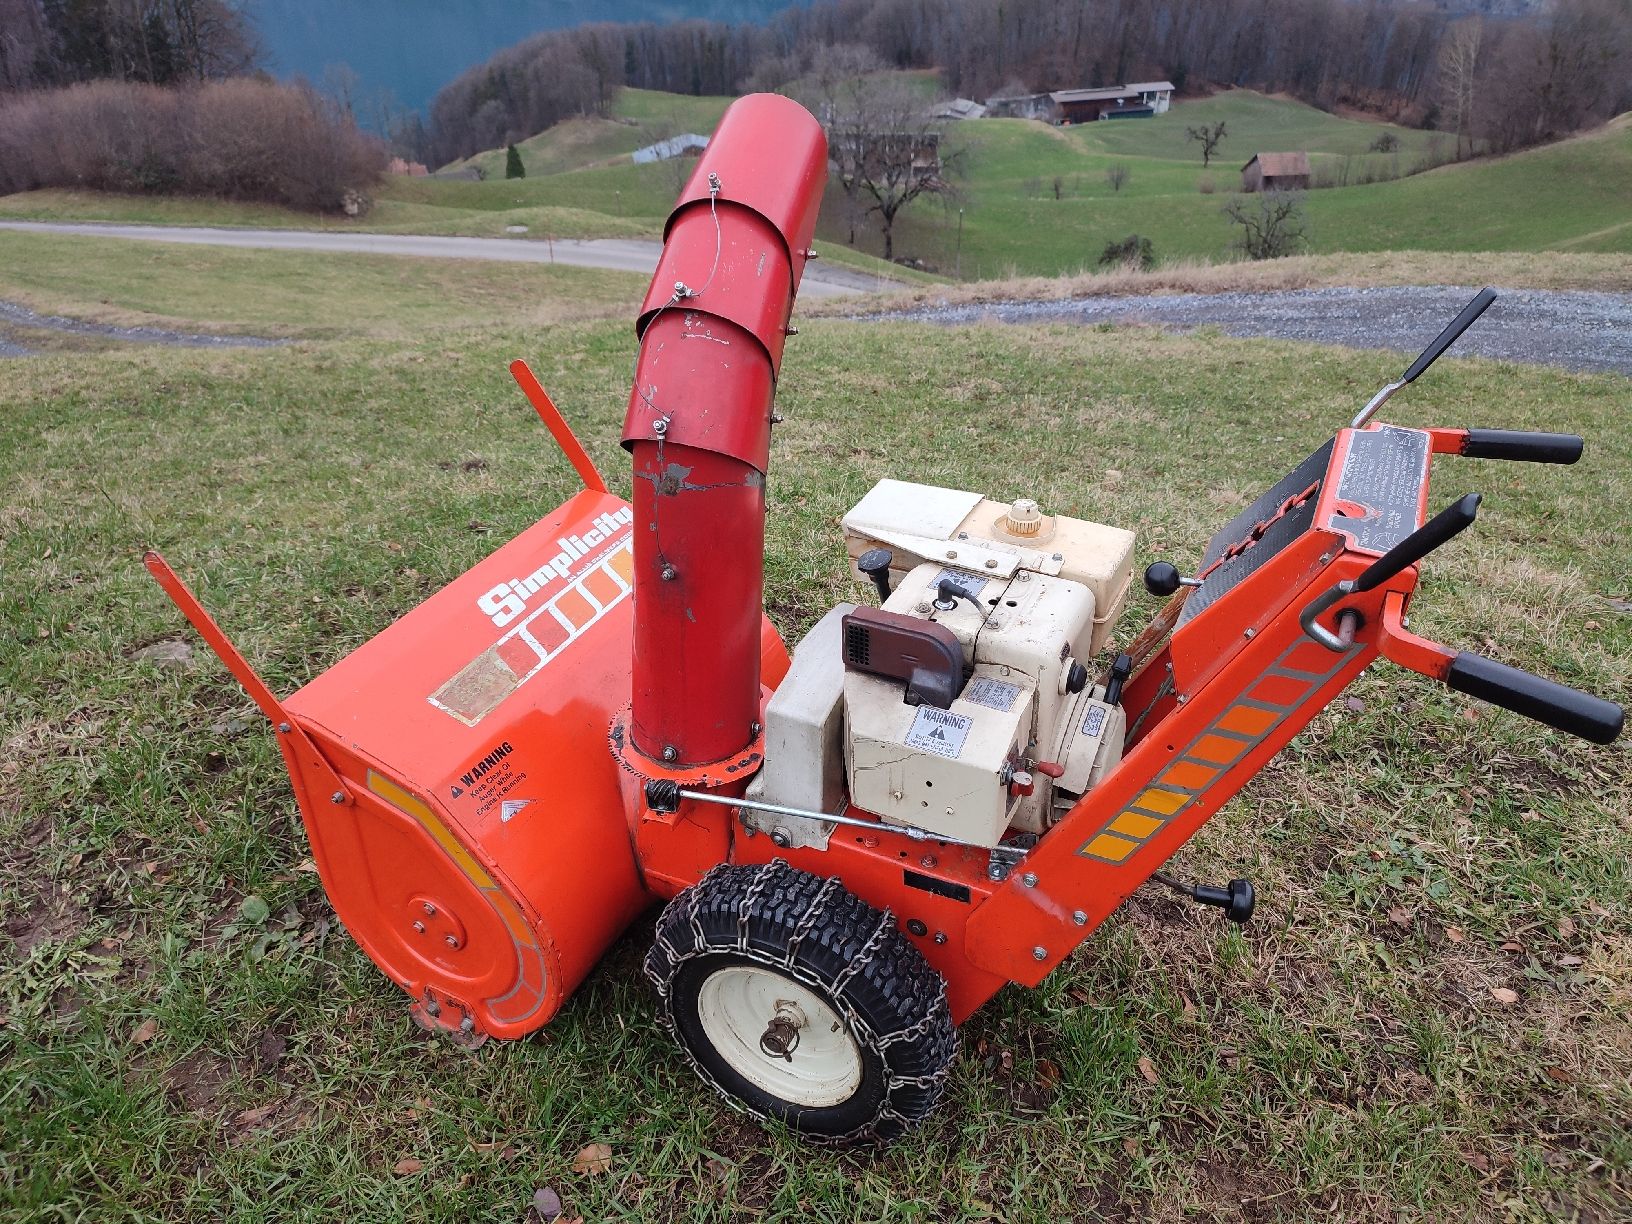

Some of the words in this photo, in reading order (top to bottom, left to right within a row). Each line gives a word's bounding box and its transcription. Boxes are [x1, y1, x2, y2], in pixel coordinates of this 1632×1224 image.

[476, 505, 632, 628] Simplicity
[923, 709, 966, 730] WARNING
[460, 741, 514, 787] WARNING
[470, 784, 487, 798] Keep
[486, 770, 502, 784] Clear
[476, 797, 497, 816] Engine
[502, 772, 527, 793] Running
[479, 786, 497, 802] Auger
[496, 771, 513, 786] While
